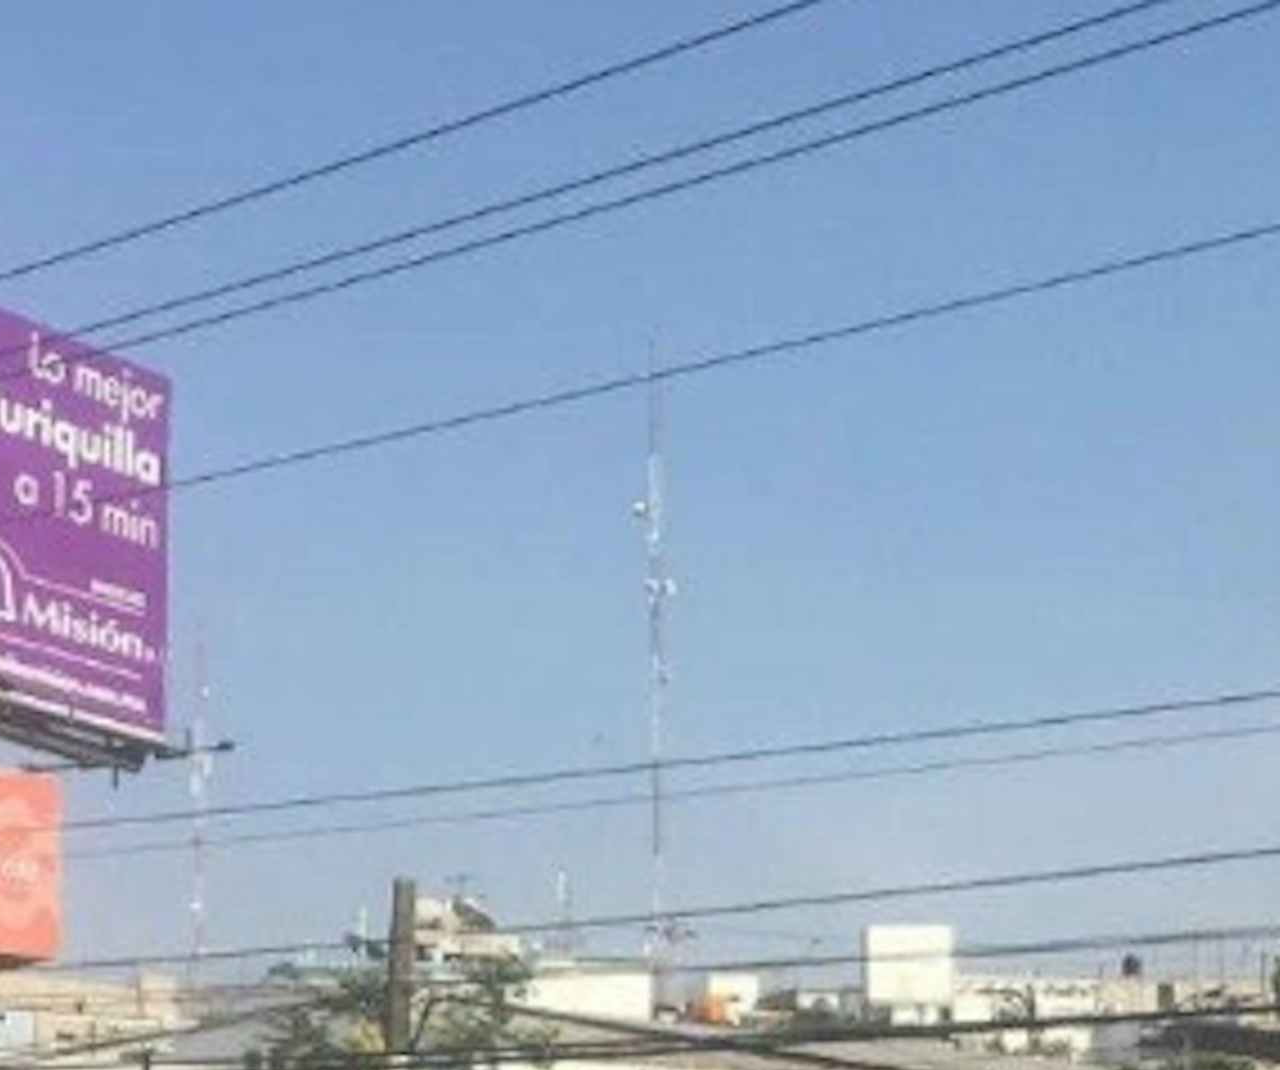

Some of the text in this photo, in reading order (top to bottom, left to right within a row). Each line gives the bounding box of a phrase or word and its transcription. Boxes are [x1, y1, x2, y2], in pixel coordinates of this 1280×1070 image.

[72, 365, 164, 424] mejor
[51, 470, 94, 526] 15
[100, 499, 158, 550] min
